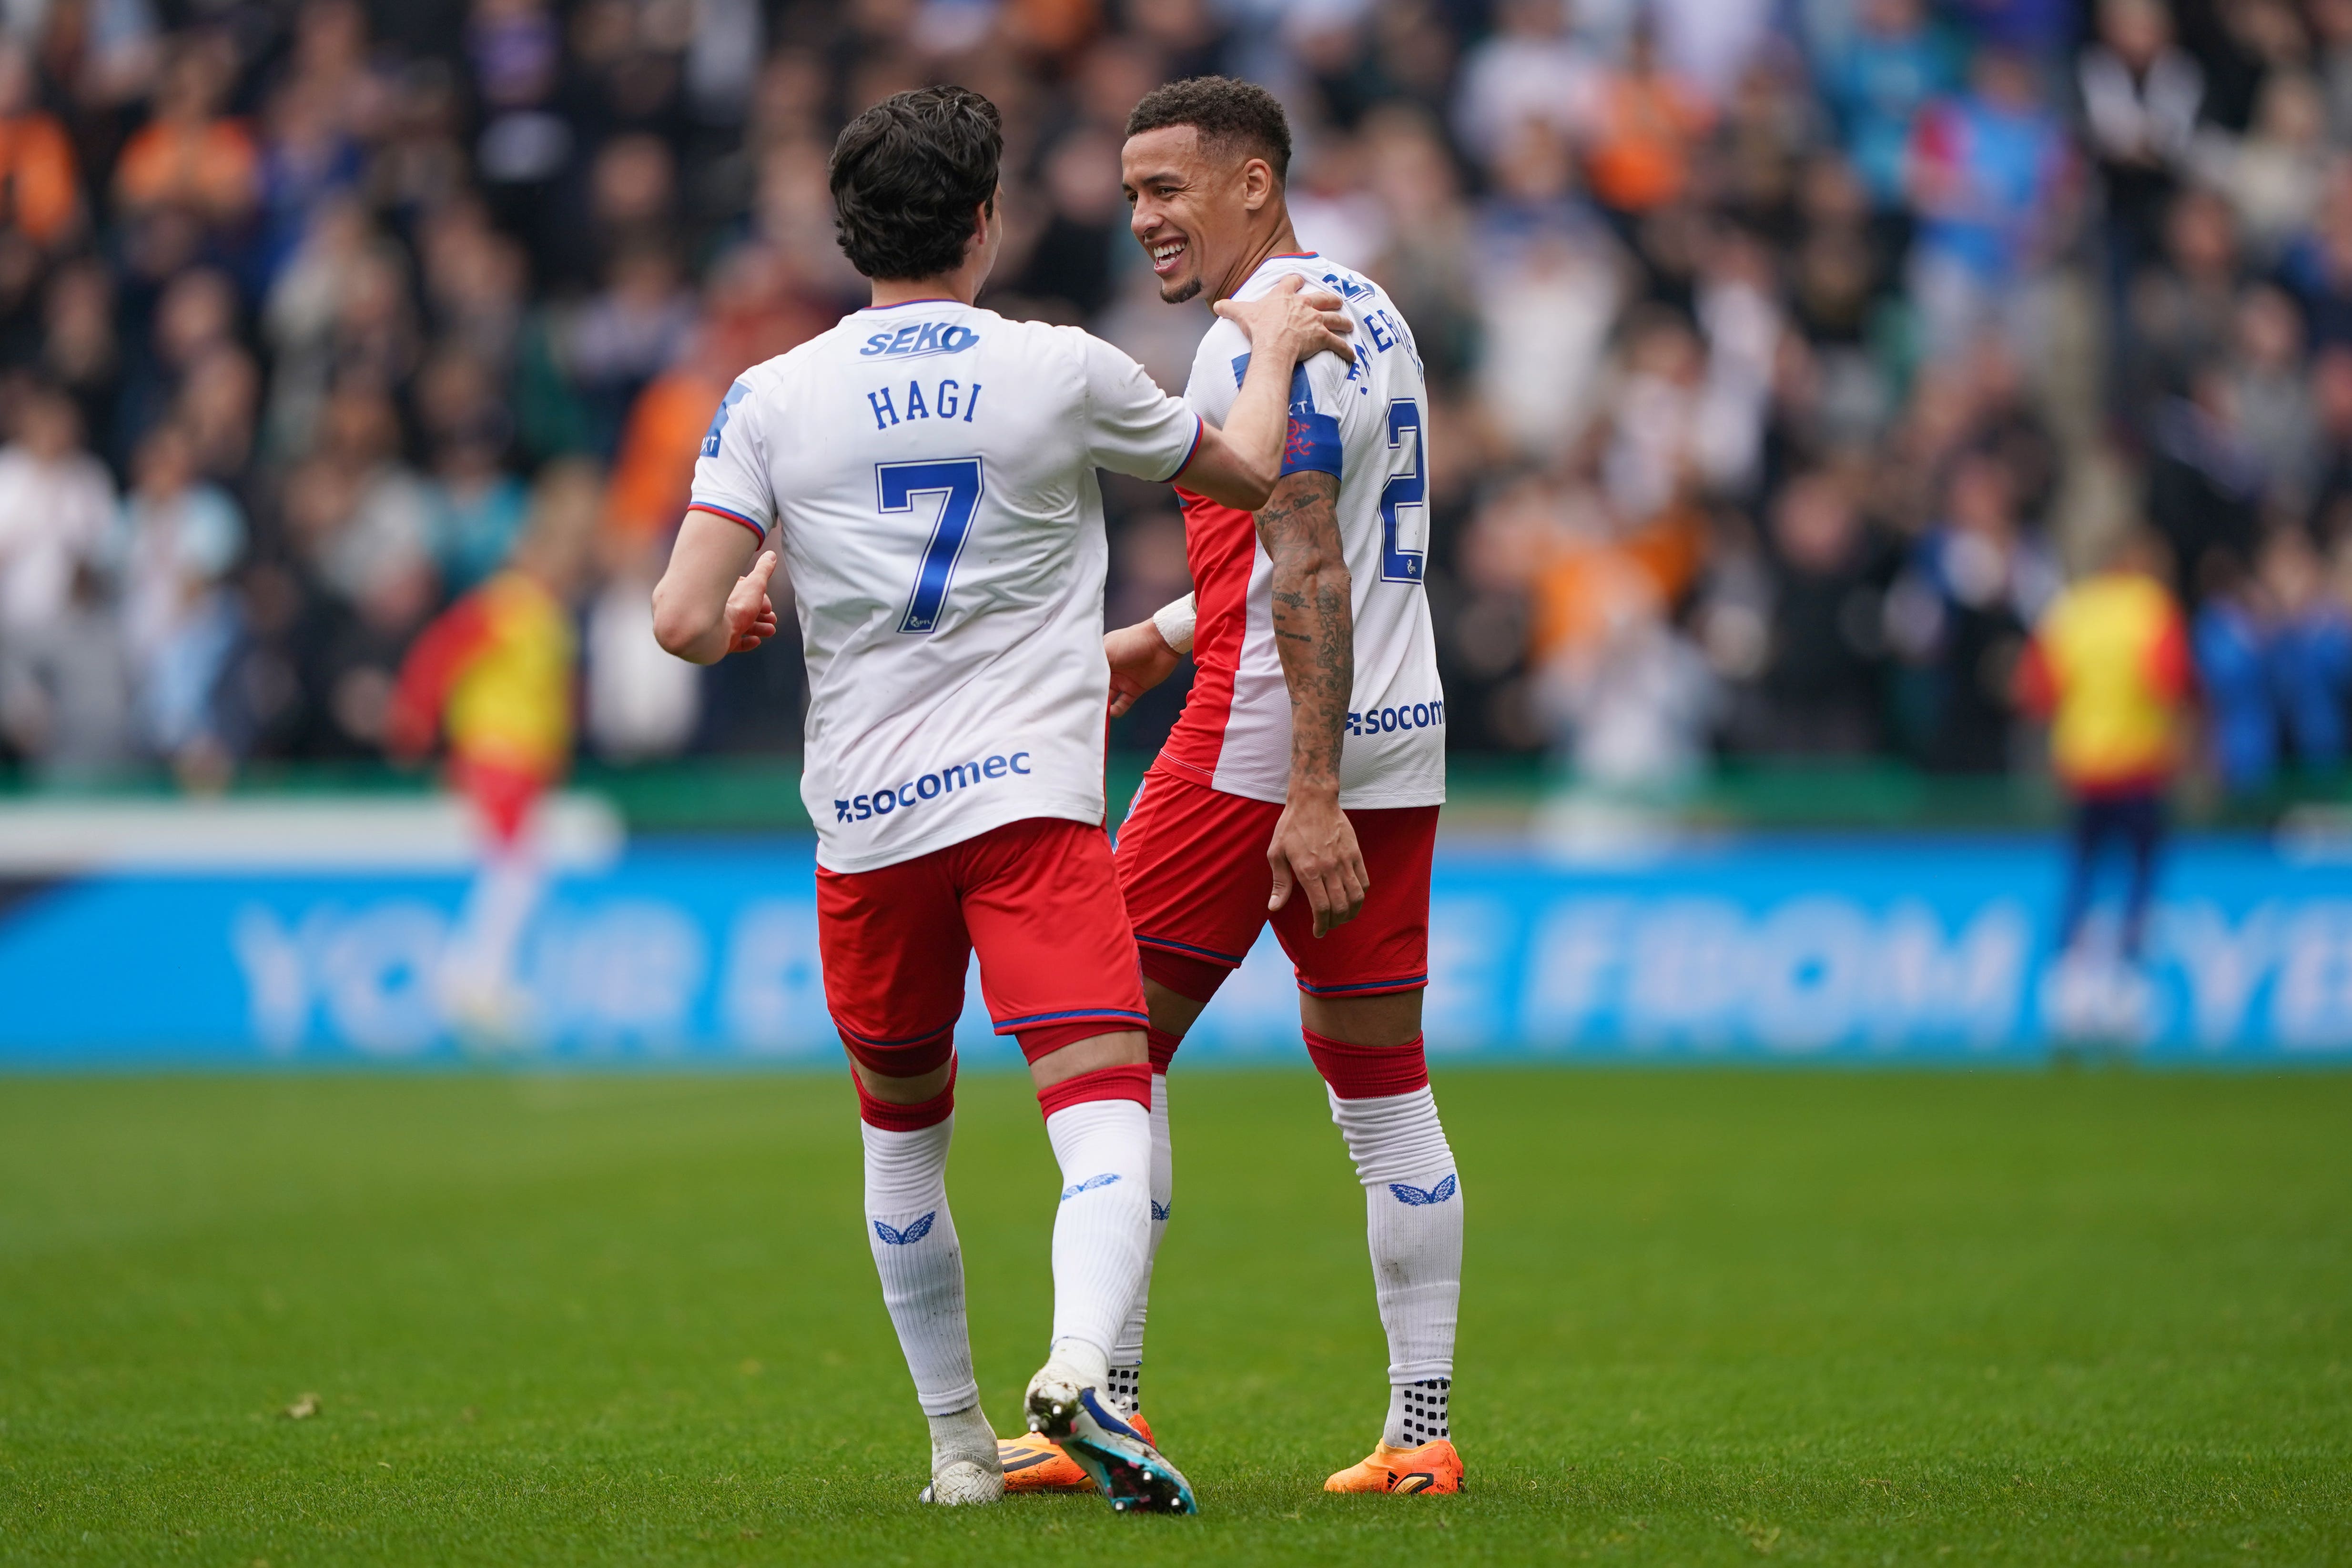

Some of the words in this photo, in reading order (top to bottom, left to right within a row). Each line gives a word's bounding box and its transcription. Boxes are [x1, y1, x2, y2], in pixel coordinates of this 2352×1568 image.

[860, 322, 980, 355] SEKO
[867, 380, 982, 430] HAGI
[1377, 398, 1425, 585] 2
[875, 456, 984, 633] 7
[851, 752, 1031, 820] socomec
